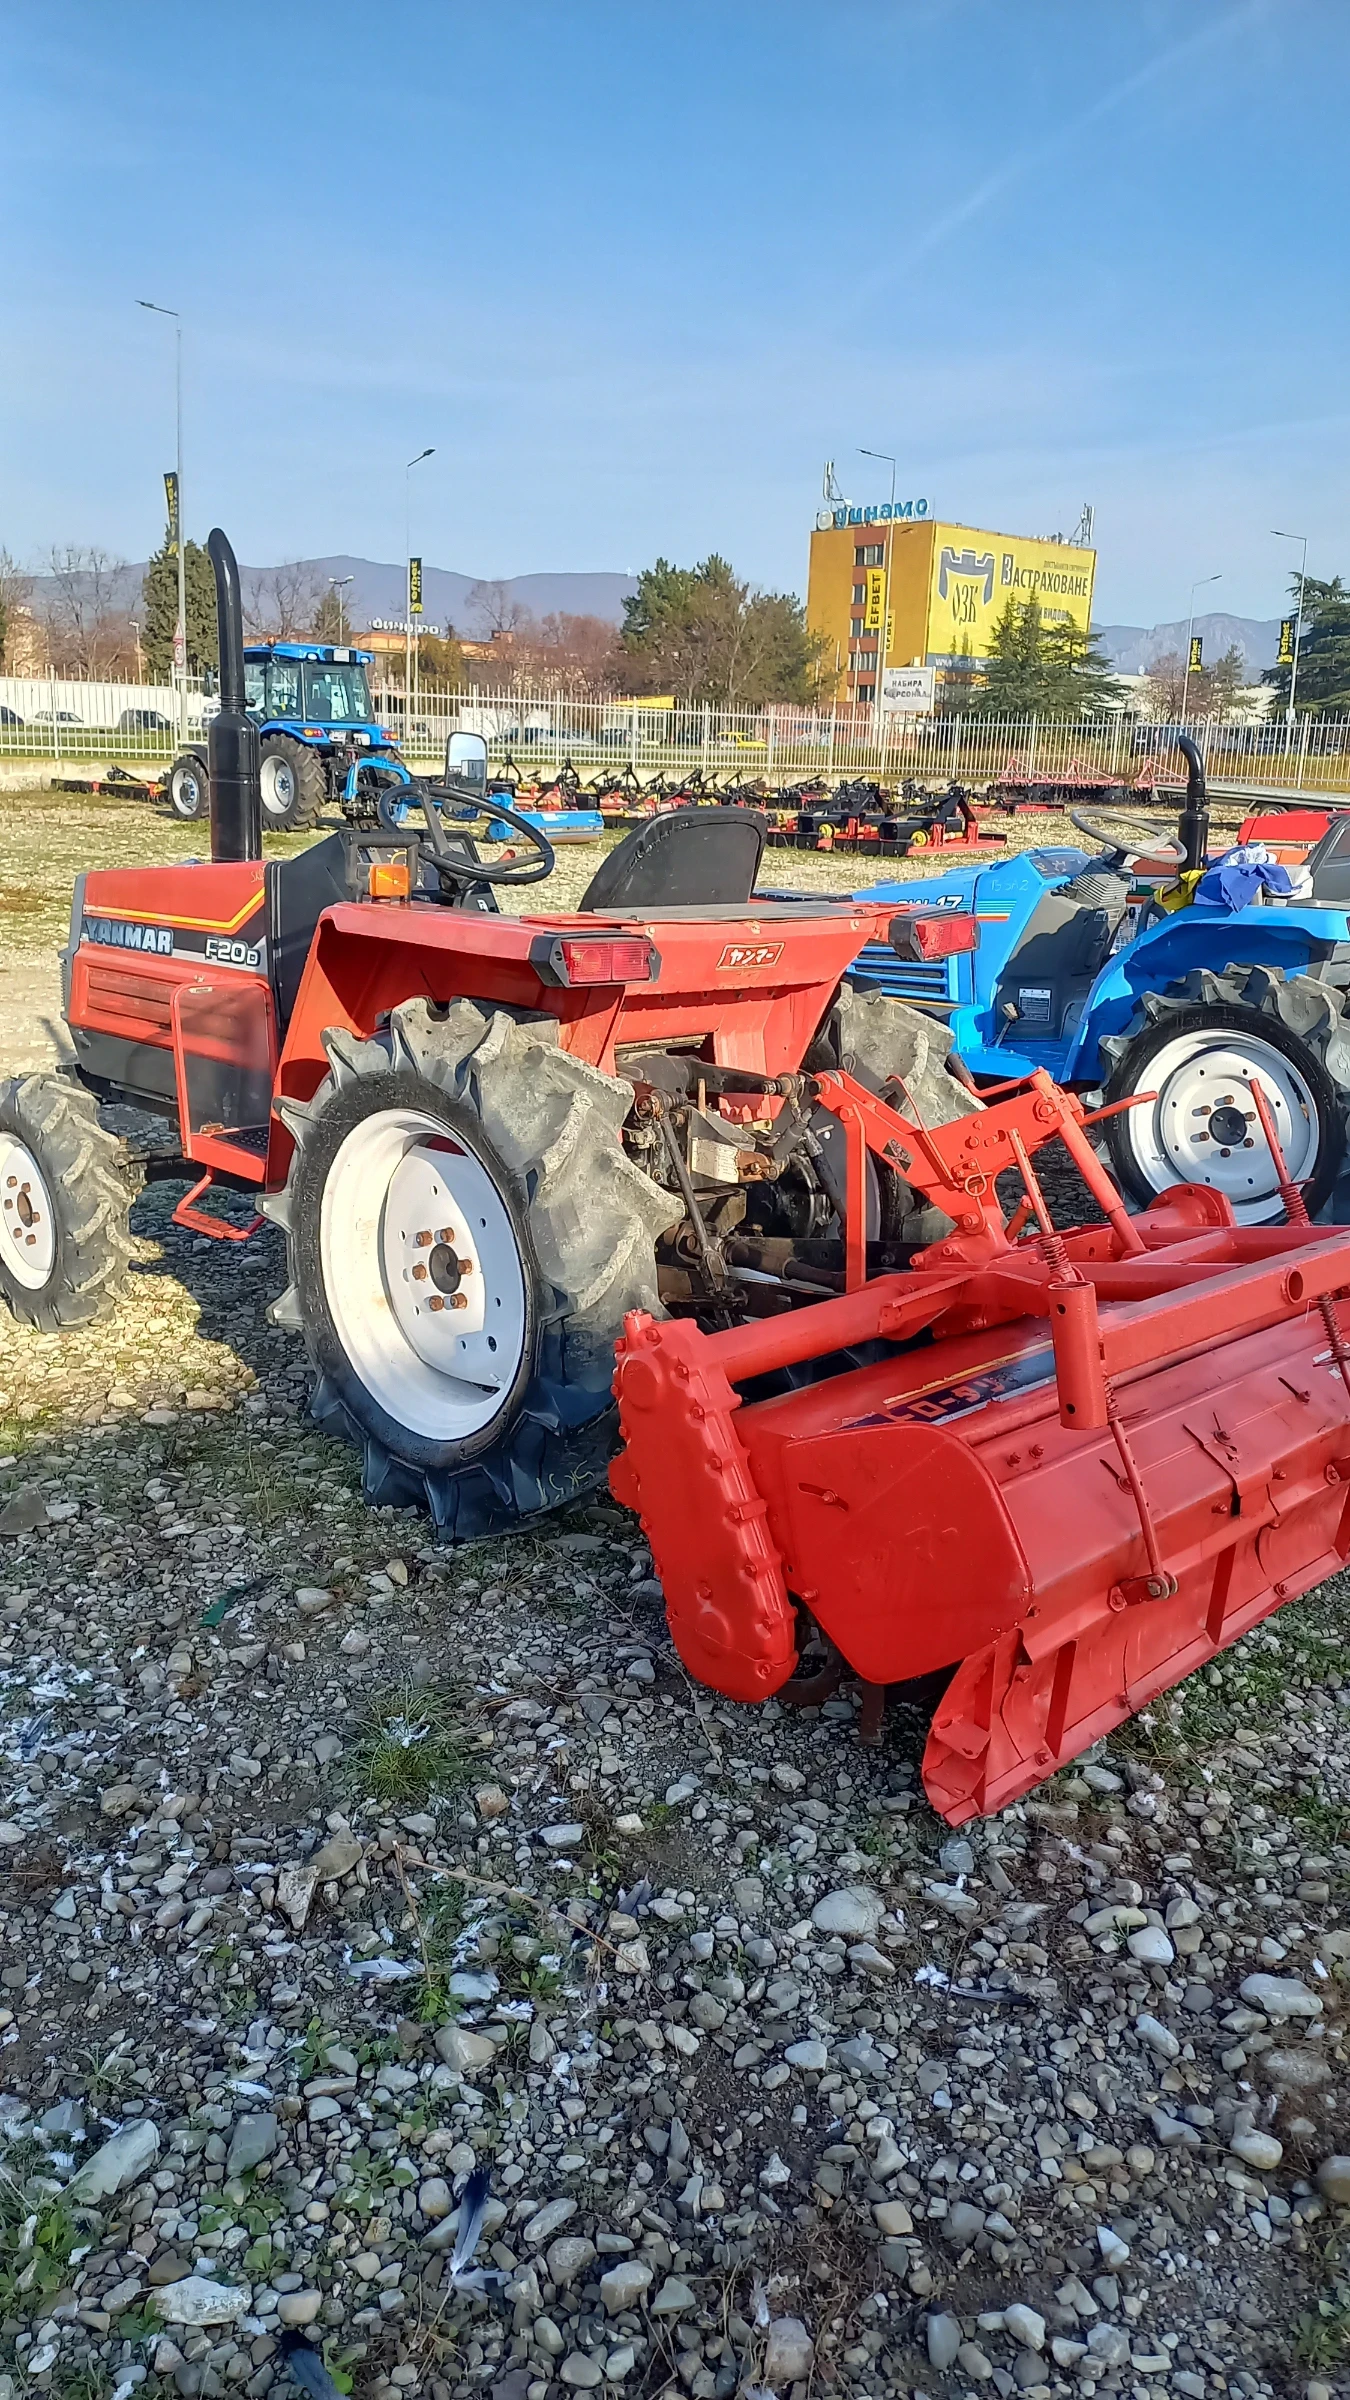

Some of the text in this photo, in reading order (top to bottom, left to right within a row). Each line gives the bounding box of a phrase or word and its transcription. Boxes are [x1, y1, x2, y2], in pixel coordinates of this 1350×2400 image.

[870, 574, 881, 625] EFBET
[83, 917, 173, 955] YANMAR
[205, 937, 260, 966] F20D
[729, 948, 774, 965] ヤンマー
